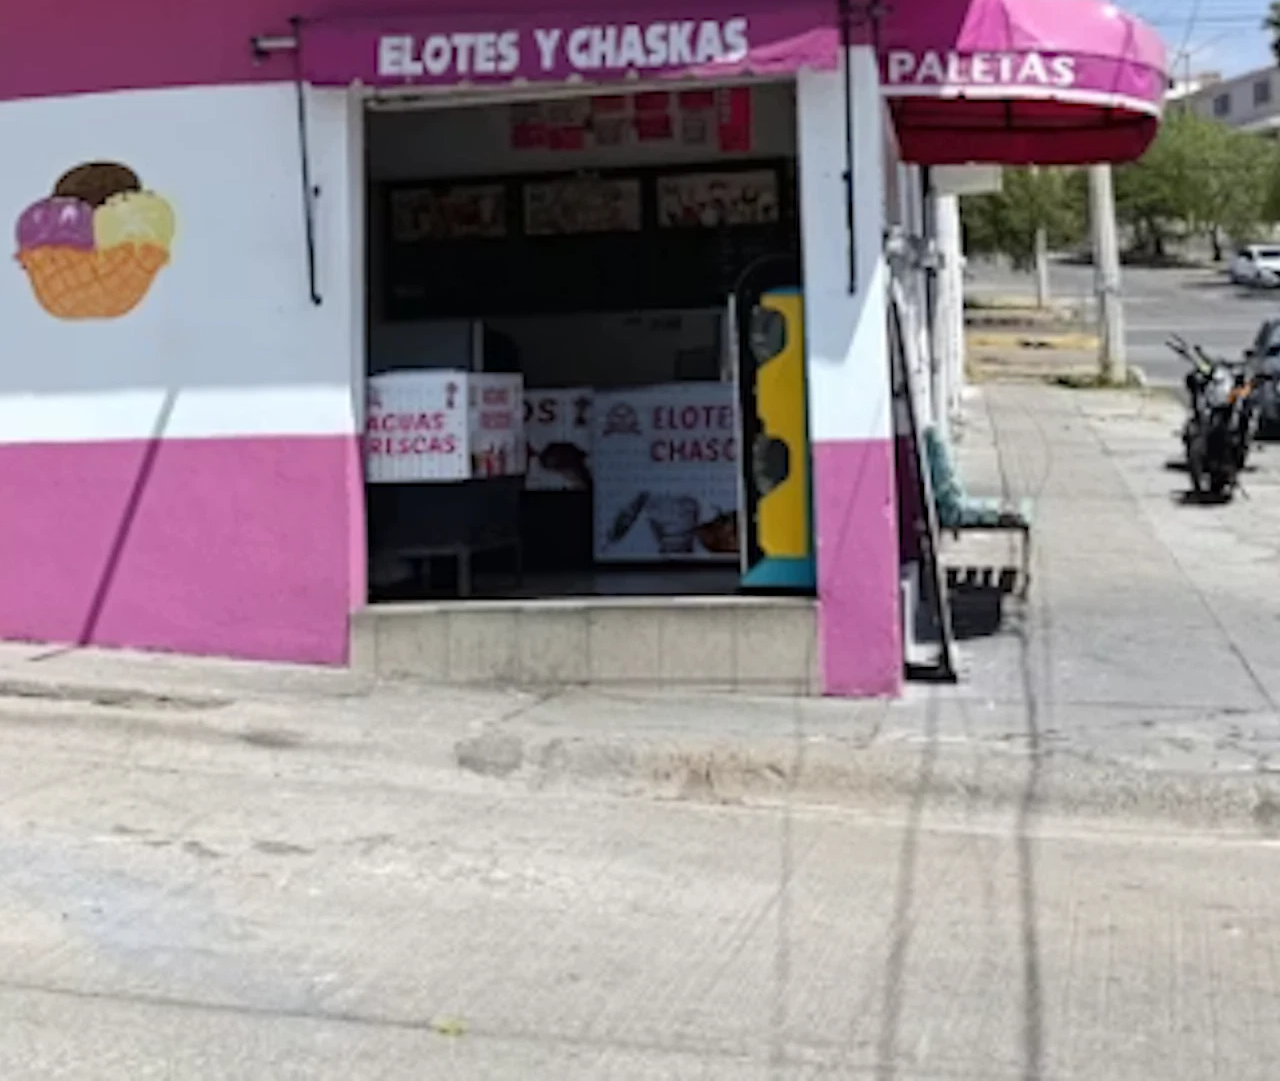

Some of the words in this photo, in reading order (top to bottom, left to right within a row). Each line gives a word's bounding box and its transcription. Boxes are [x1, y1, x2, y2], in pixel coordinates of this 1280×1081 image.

[377, 31, 519, 77] ELOTES
[533, 27, 562, 70] Y
[566, 17, 749, 70] CHASKAS
[886, 50, 1076, 86] PALETAS
[651, 405, 733, 429] ELOTE
[650, 437, 738, 462] CHASC
